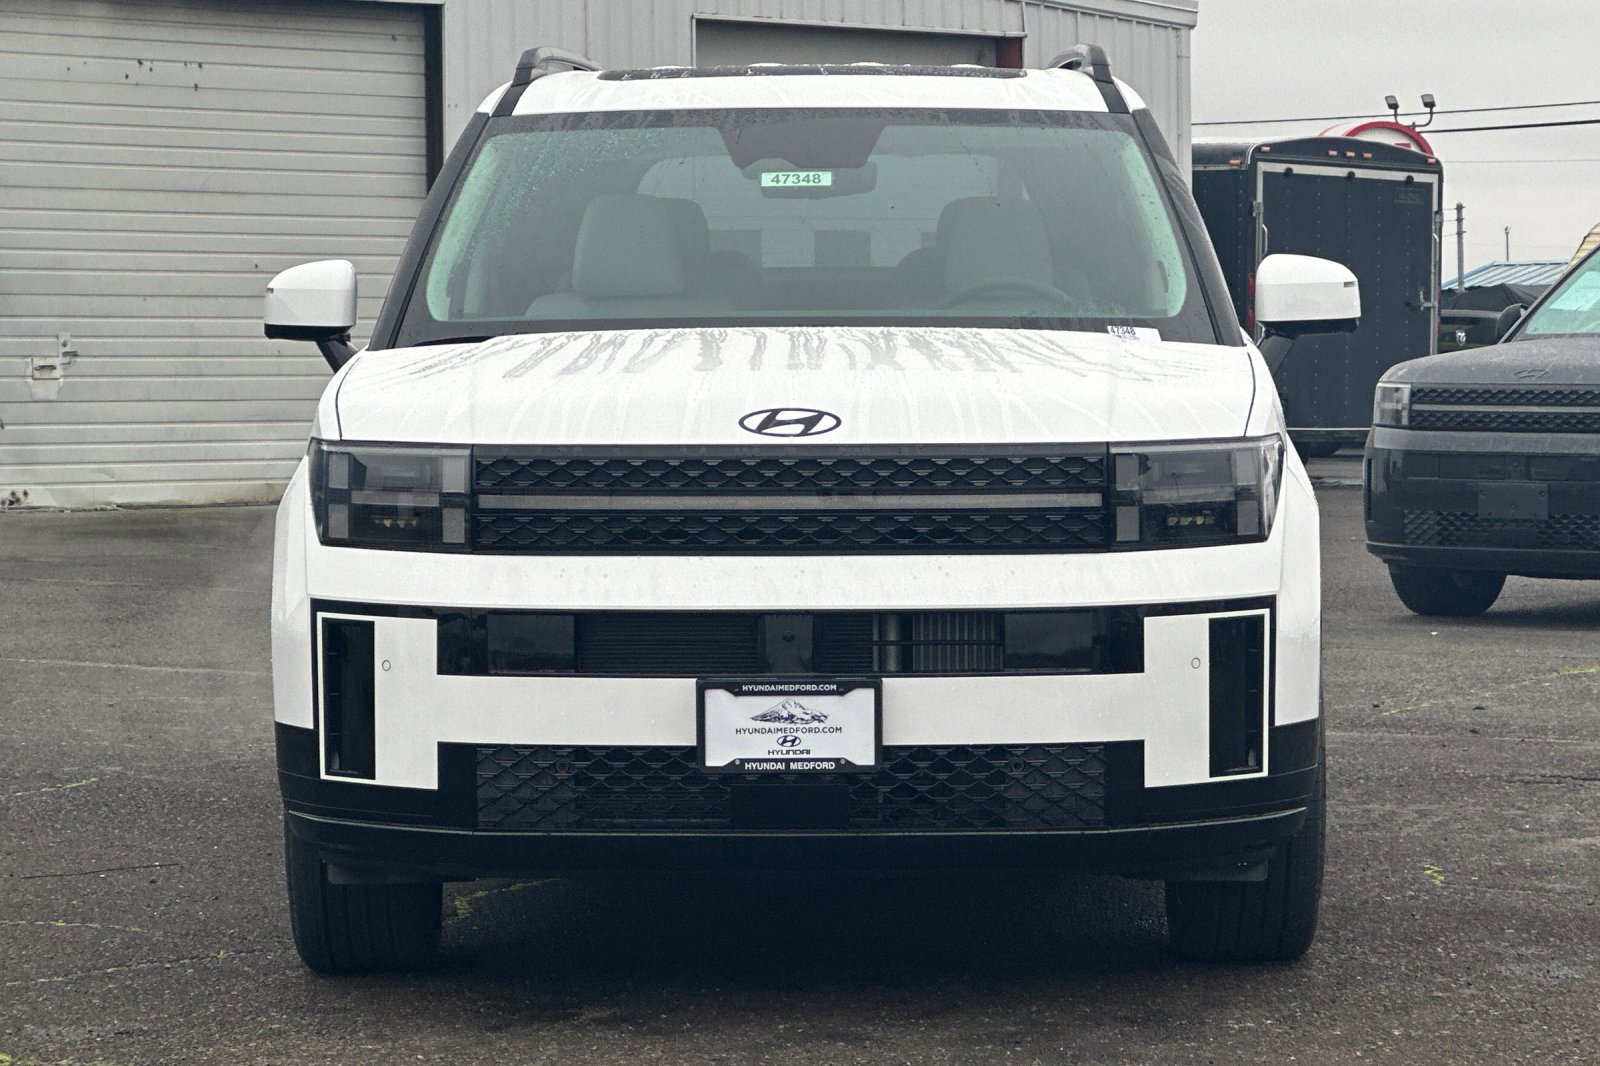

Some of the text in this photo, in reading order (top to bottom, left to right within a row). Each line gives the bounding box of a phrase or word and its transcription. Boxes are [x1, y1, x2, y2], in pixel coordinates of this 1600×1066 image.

[770, 173, 822, 185] 47348
[742, 684, 837, 692] HYUNDAIMEDFORD.COM
[735, 726, 842, 735] HYUNDAIMEDFORD.COM
[744, 761, 836, 770] HYUNDAI MEDFORD
